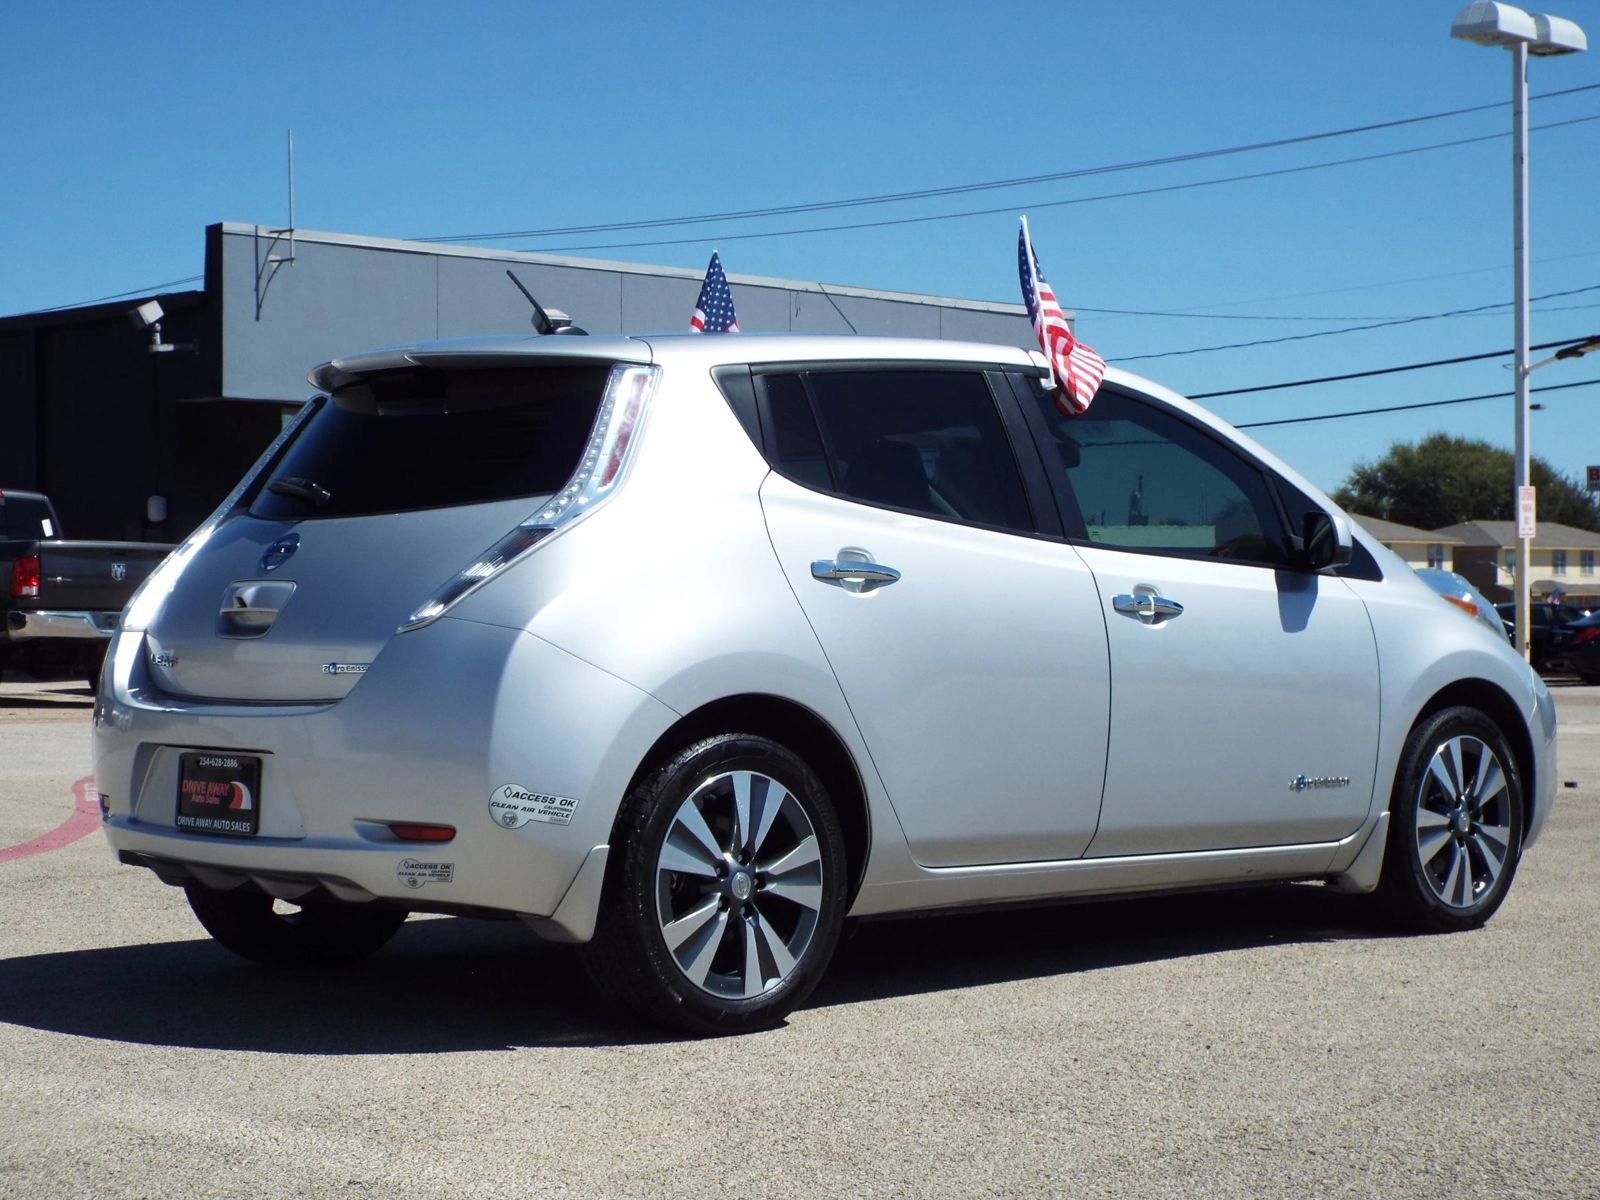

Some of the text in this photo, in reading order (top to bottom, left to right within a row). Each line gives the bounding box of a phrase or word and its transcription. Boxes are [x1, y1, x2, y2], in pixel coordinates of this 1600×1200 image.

[200, 757, 237, 767] 254-628-2886
[183, 780, 229, 796] DRIVE AWAY
[512, 792, 577, 808] ACCESS OK
[491, 801, 519, 810] CLEAN
[538, 808, 571, 818] VEHICLE
[177, 816, 250, 832] DRIVE AWAY AUTO SALES
